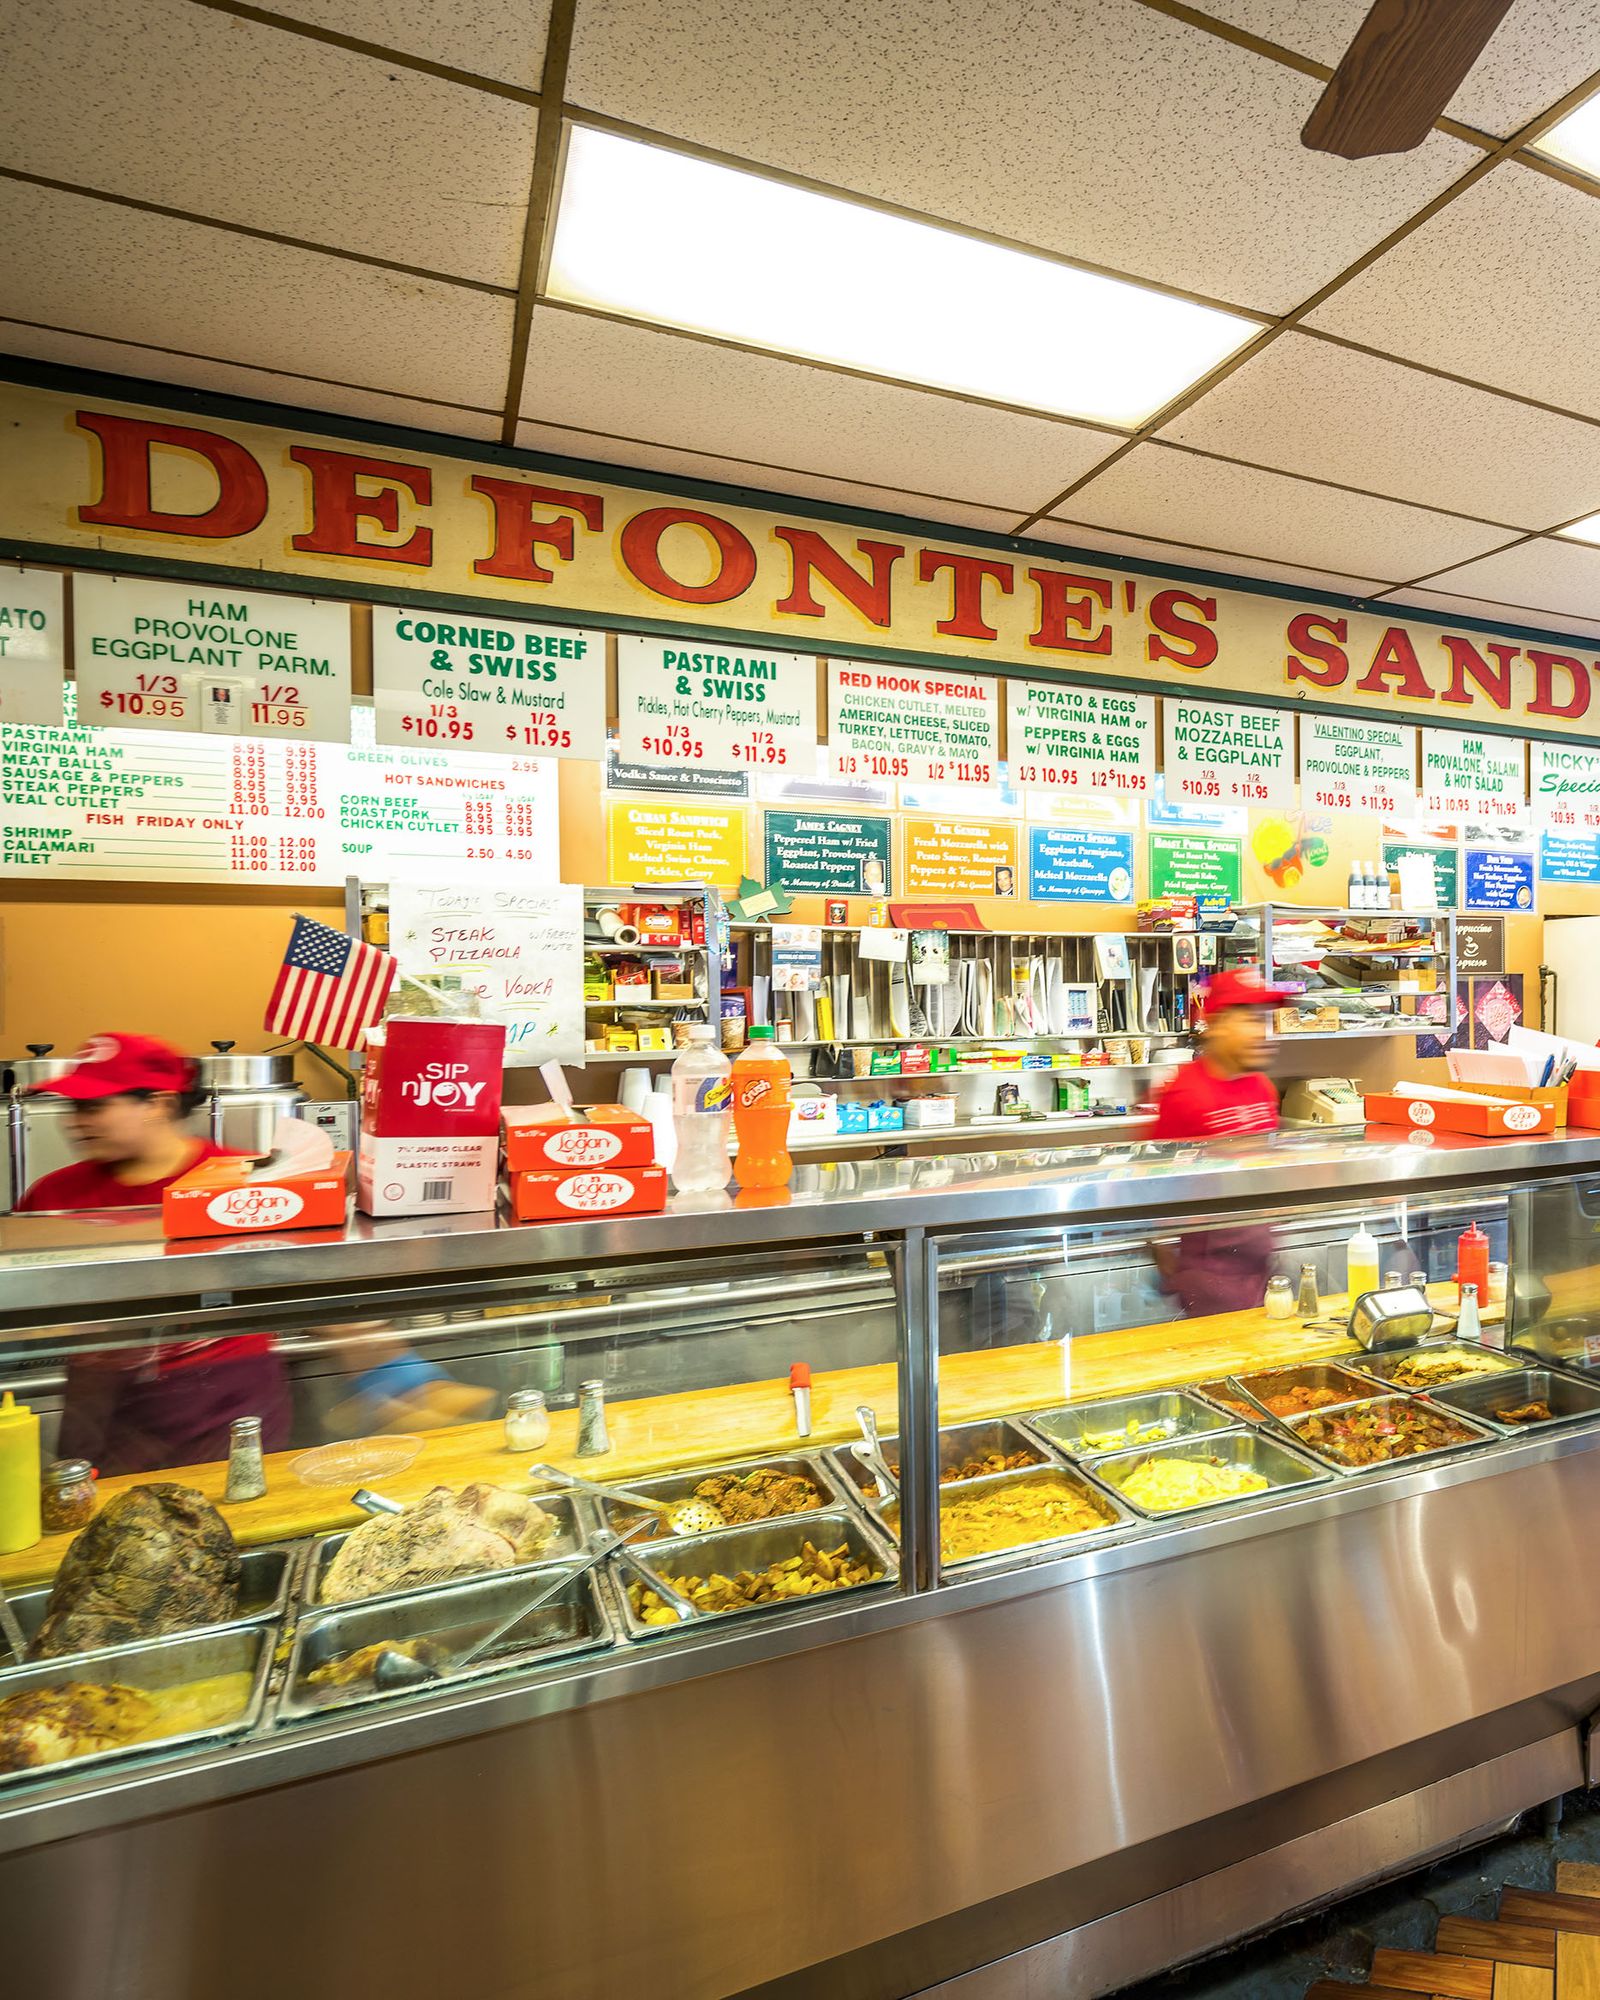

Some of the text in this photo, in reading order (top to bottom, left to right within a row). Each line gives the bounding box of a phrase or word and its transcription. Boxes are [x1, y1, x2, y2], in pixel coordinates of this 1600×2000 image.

[75, 409, 1600, 719] DEFONTE'S SAND
[188, 599, 248, 622] HAM
[135, 617, 298, 650] PROVOLONE
[396, 619, 588, 660] CORNED BEEF
[92, 637, 336, 677] EGGPLANT PARM.
[430, 649, 557, 682] & SWISS
[663, 650, 777, 680] PASTRAMI
[136, 674, 299, 704] 1/3 1/2
[422, 678, 565, 710] Cole Slaw & Mustard
[675, 675, 766, 702] & SWISS
[839, 671, 987, 701] RED HOOK SPECIAL
[100, 690, 185, 718] $10.95
[251, 702, 306, 727] 11.95
[637, 696, 801, 727] Pickles, Hot Cherry Peppers, Mustard
[844, 693, 986, 718] CHICKEN CUTLET, MELTED
[1028, 689, 1136, 713] POTATO & EGGS
[430, 704, 557, 726] 1/3 1/2
[839, 708, 991, 733] AMERICAN CHEESE, SLICED
[1016, 705, 1147, 729] w/ VIRGINIA HAM or
[1178, 708, 1280, 732] ROAST BEEF
[2, 728, 93, 743] PASTRAMI
[401, 715, 474, 741] $10.95
[666, 725, 774, 744] 1/3 1/2
[838, 722, 991, 748] TURKEY, LETTUCE, TOMATO,
[1024, 726, 1140, 749] PEPPERS & EGGS
[1175, 726, 1283, 750] MOZZARELLA
[1315, 723, 1402, 744] VALENTINO SPECIAL
[2, 741, 124, 758] VIRGINIA HAM
[347, 752, 449, 767] GREEN OLIVES
[642, 736, 787, 765] $10.95 $11.95
[852, 738, 979, 760] BACON, GRAVY & MAYO
[1026, 743, 1139, 764] w/ VIRGINIA HAM
[1178, 745, 1282, 768] & EGGPLANT
[1335, 744, 1383, 761] EGGPLANT,
[1463, 739, 1486, 759] HAM,
[2, 754, 113, 770] MEAT BALLS
[839, 754, 990, 783] 1/3 $10.95 1/2 $11.95
[1306, 759, 1410, 780] PROVOLONE & PEPPERS
[1427, 753, 1520, 777] PROVALONE, SALAMI
[2, 767, 184, 787] SAUSAGE & PEPPERS
[384, 774, 506, 790] HOT SANDWICHES
[613, 768, 648, 780] Vodka
[648, 770, 678, 783] Sauce
[679, 773, 691, 783] &
[1020, 766, 1146, 790] 1/3 10.95 1/2 $11.95
[1444, 772, 1504, 793] & HOT SALAD
[2, 780, 144, 797] STEAK PEPPERS
[1182, 779, 1220, 797] $10.95
[3, 793, 119, 809] VEAL CUTLET
[340, 795, 419, 808] CORN BEEF
[1316, 792, 1351, 807] $10.95
[86, 814, 244, 830] FISH FRIDAY ONLY
[340, 806, 430, 820] ROAST PORK
[340, 818, 460, 833] CHICKEN CUTLET
[3, 827, 316, 848] SHRIMP 11.00 12.00
[3, 840, 95, 853] CALAMARI
[773, 833, 816, 846] Peppered
[817, 836, 841, 846] Ham
[855, 838, 879, 848] Fried
[341, 843, 533, 860] SOUP 2.50 4.50
[4, 853, 316, 872] FILET 11.00 12.00
[782, 859, 856, 874] Roasted Peppers
[431, 927, 496, 943] STEAK
[429, 945, 521, 963] PIZZAIOLA
[505, 975, 553, 998] VODKA
[426, 1062, 469, 1080] SIP
[741, 1079, 772, 1108] Crush
[557, 1132, 612, 1154] Logan
[396, 1160, 482, 1169] PLASTIC STRAWS
[566, 1154, 606, 1163] WRAP
[569, 1177, 624, 1199] Logan
[224, 1191, 290, 1215] Logan
[578, 1199, 617, 1208] WRAP
[234, 1214, 283, 1225] WRAP
